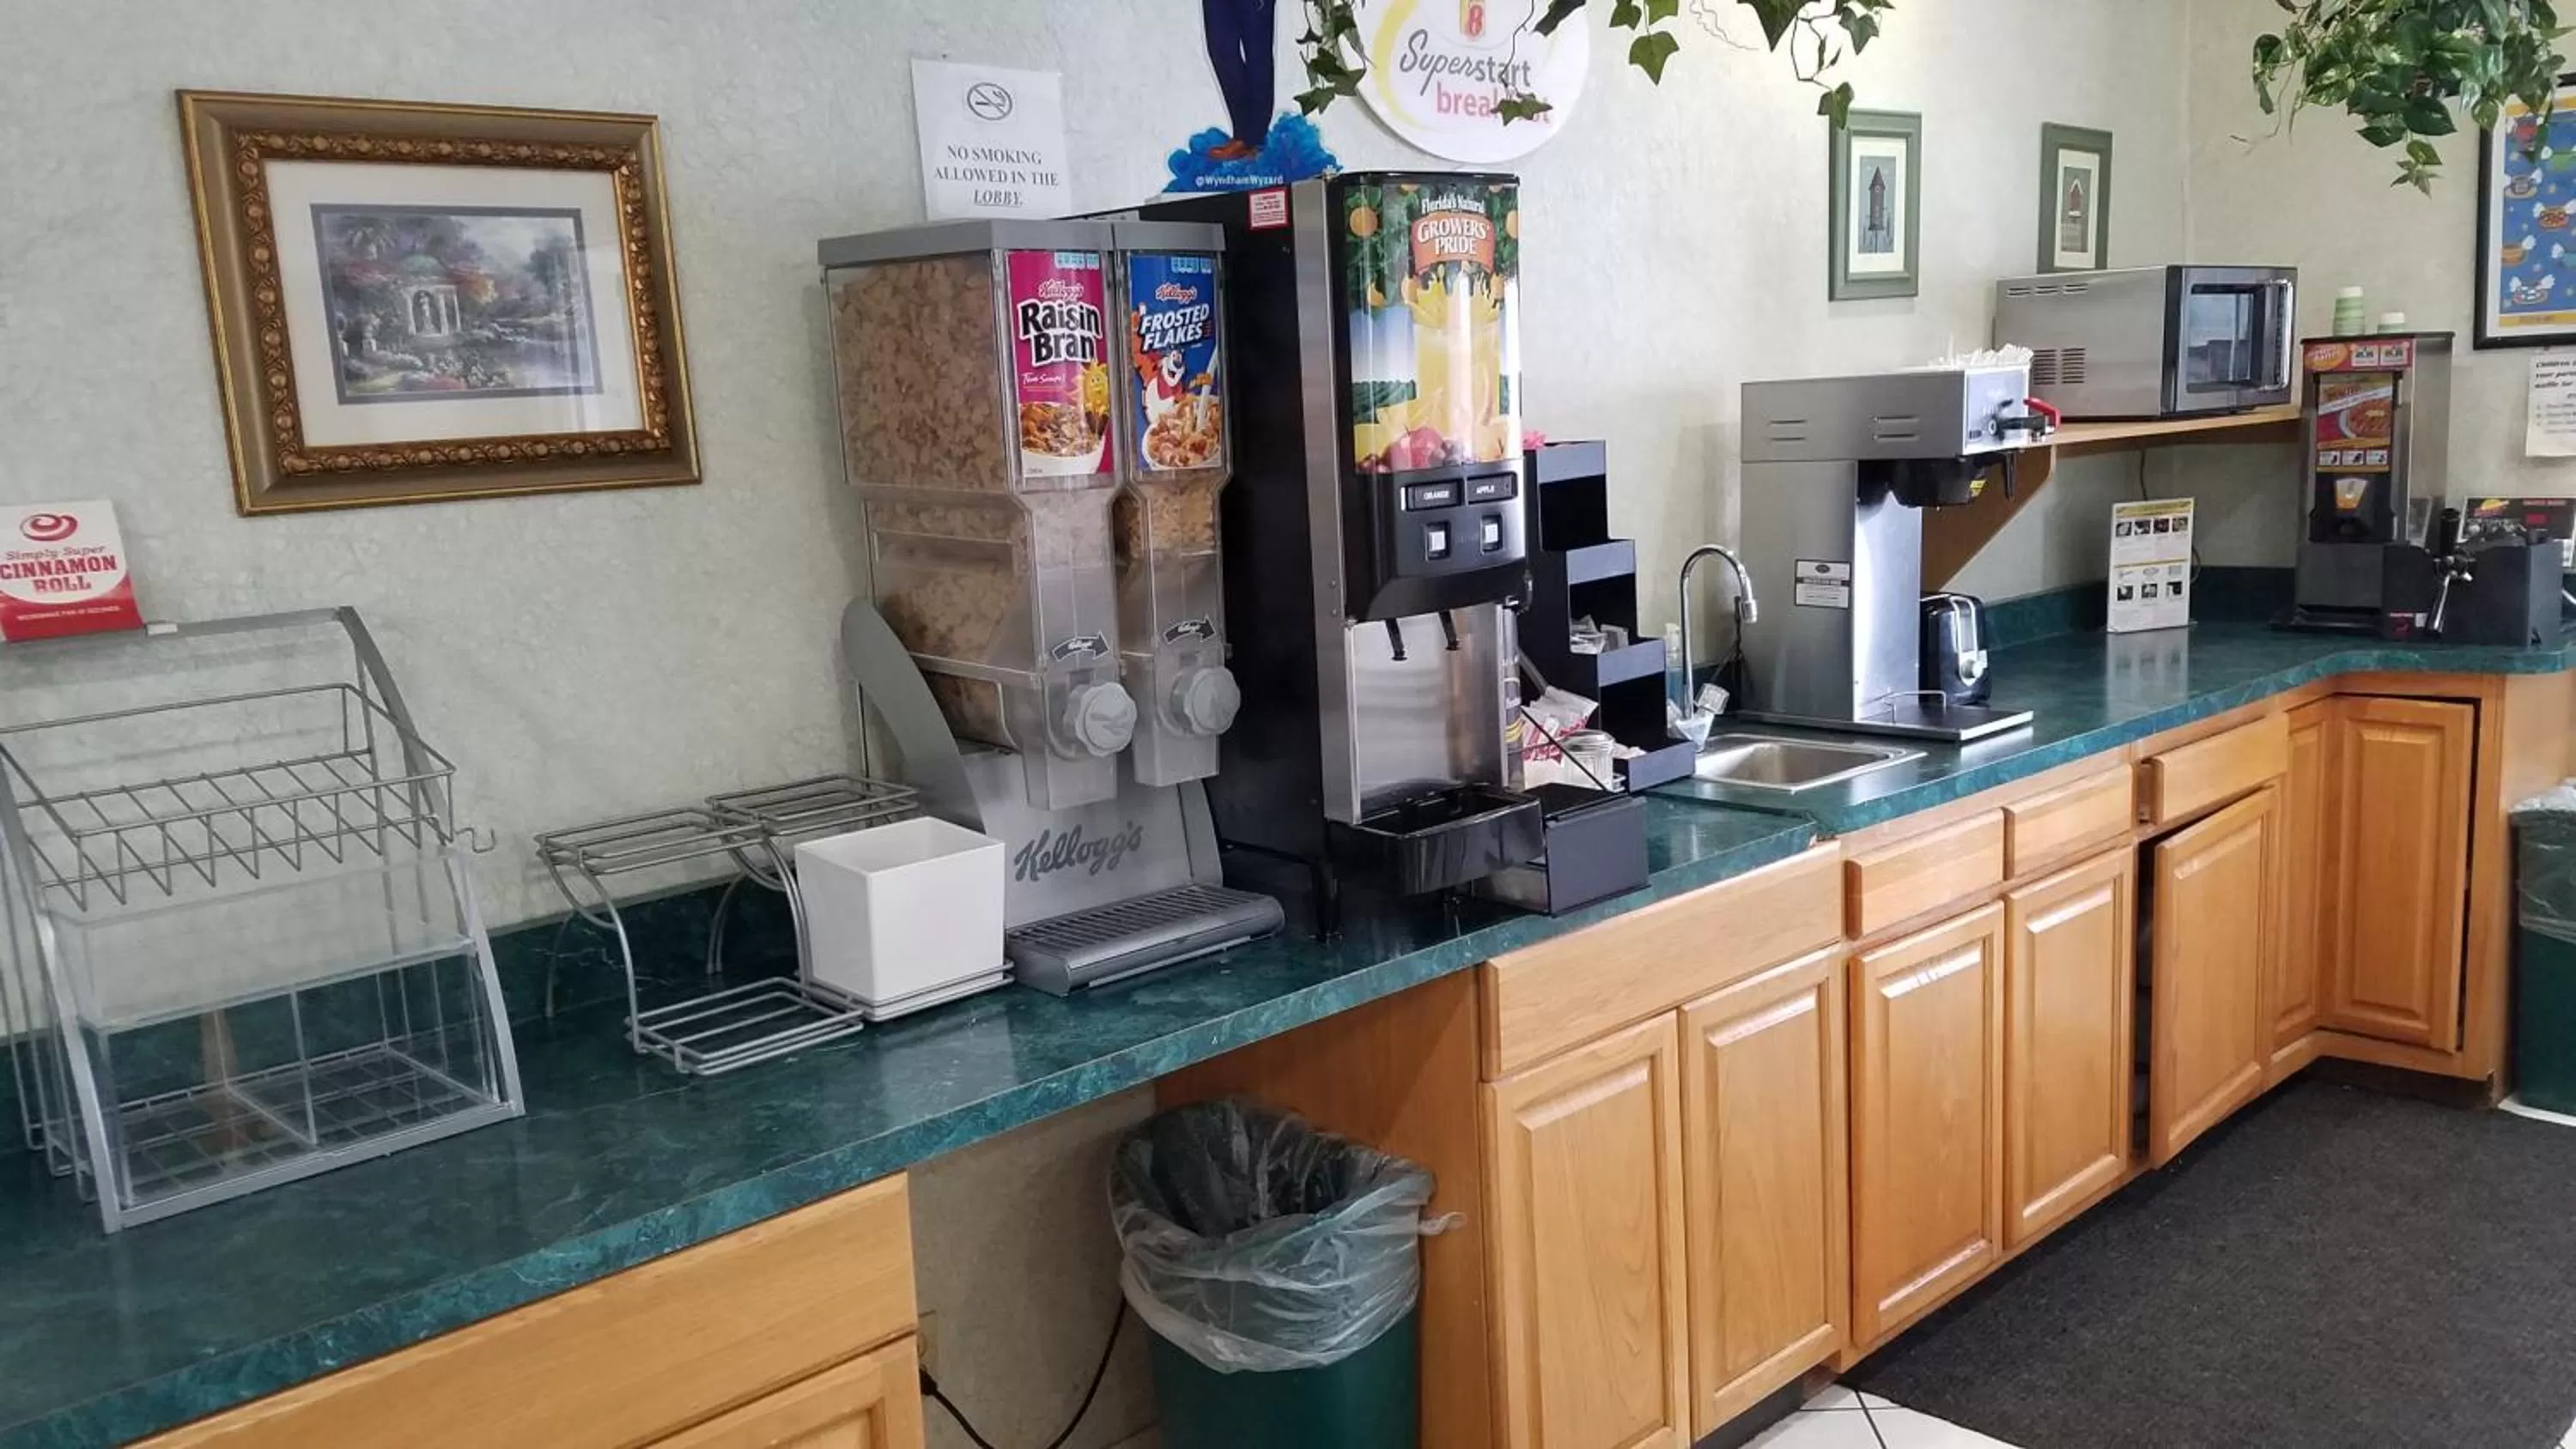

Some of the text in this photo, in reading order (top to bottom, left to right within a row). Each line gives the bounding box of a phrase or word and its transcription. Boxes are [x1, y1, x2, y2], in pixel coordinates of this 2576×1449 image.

[1399, 29, 1531, 96] Superstart
[947, 144, 1042, 165] NO SMOKING
[933, 167, 1059, 186] ALLOWED IN THE
[1194, 174, 1285, 187] @WyndhamWyzard
[1435, 236, 1478, 255] PRIDE
[1019, 300, 1102, 338] Raisin
[1141, 303, 1210, 334] FROSTED
[1031, 332, 1097, 365] Bran
[1143, 322, 1203, 351] FLAKES
[5, 546, 106, 561] Simply Super
[0, 555, 118, 579] CINNAMON
[32, 576, 92, 592] ROLL
[1014, 821, 1143, 882] Kellogg's
